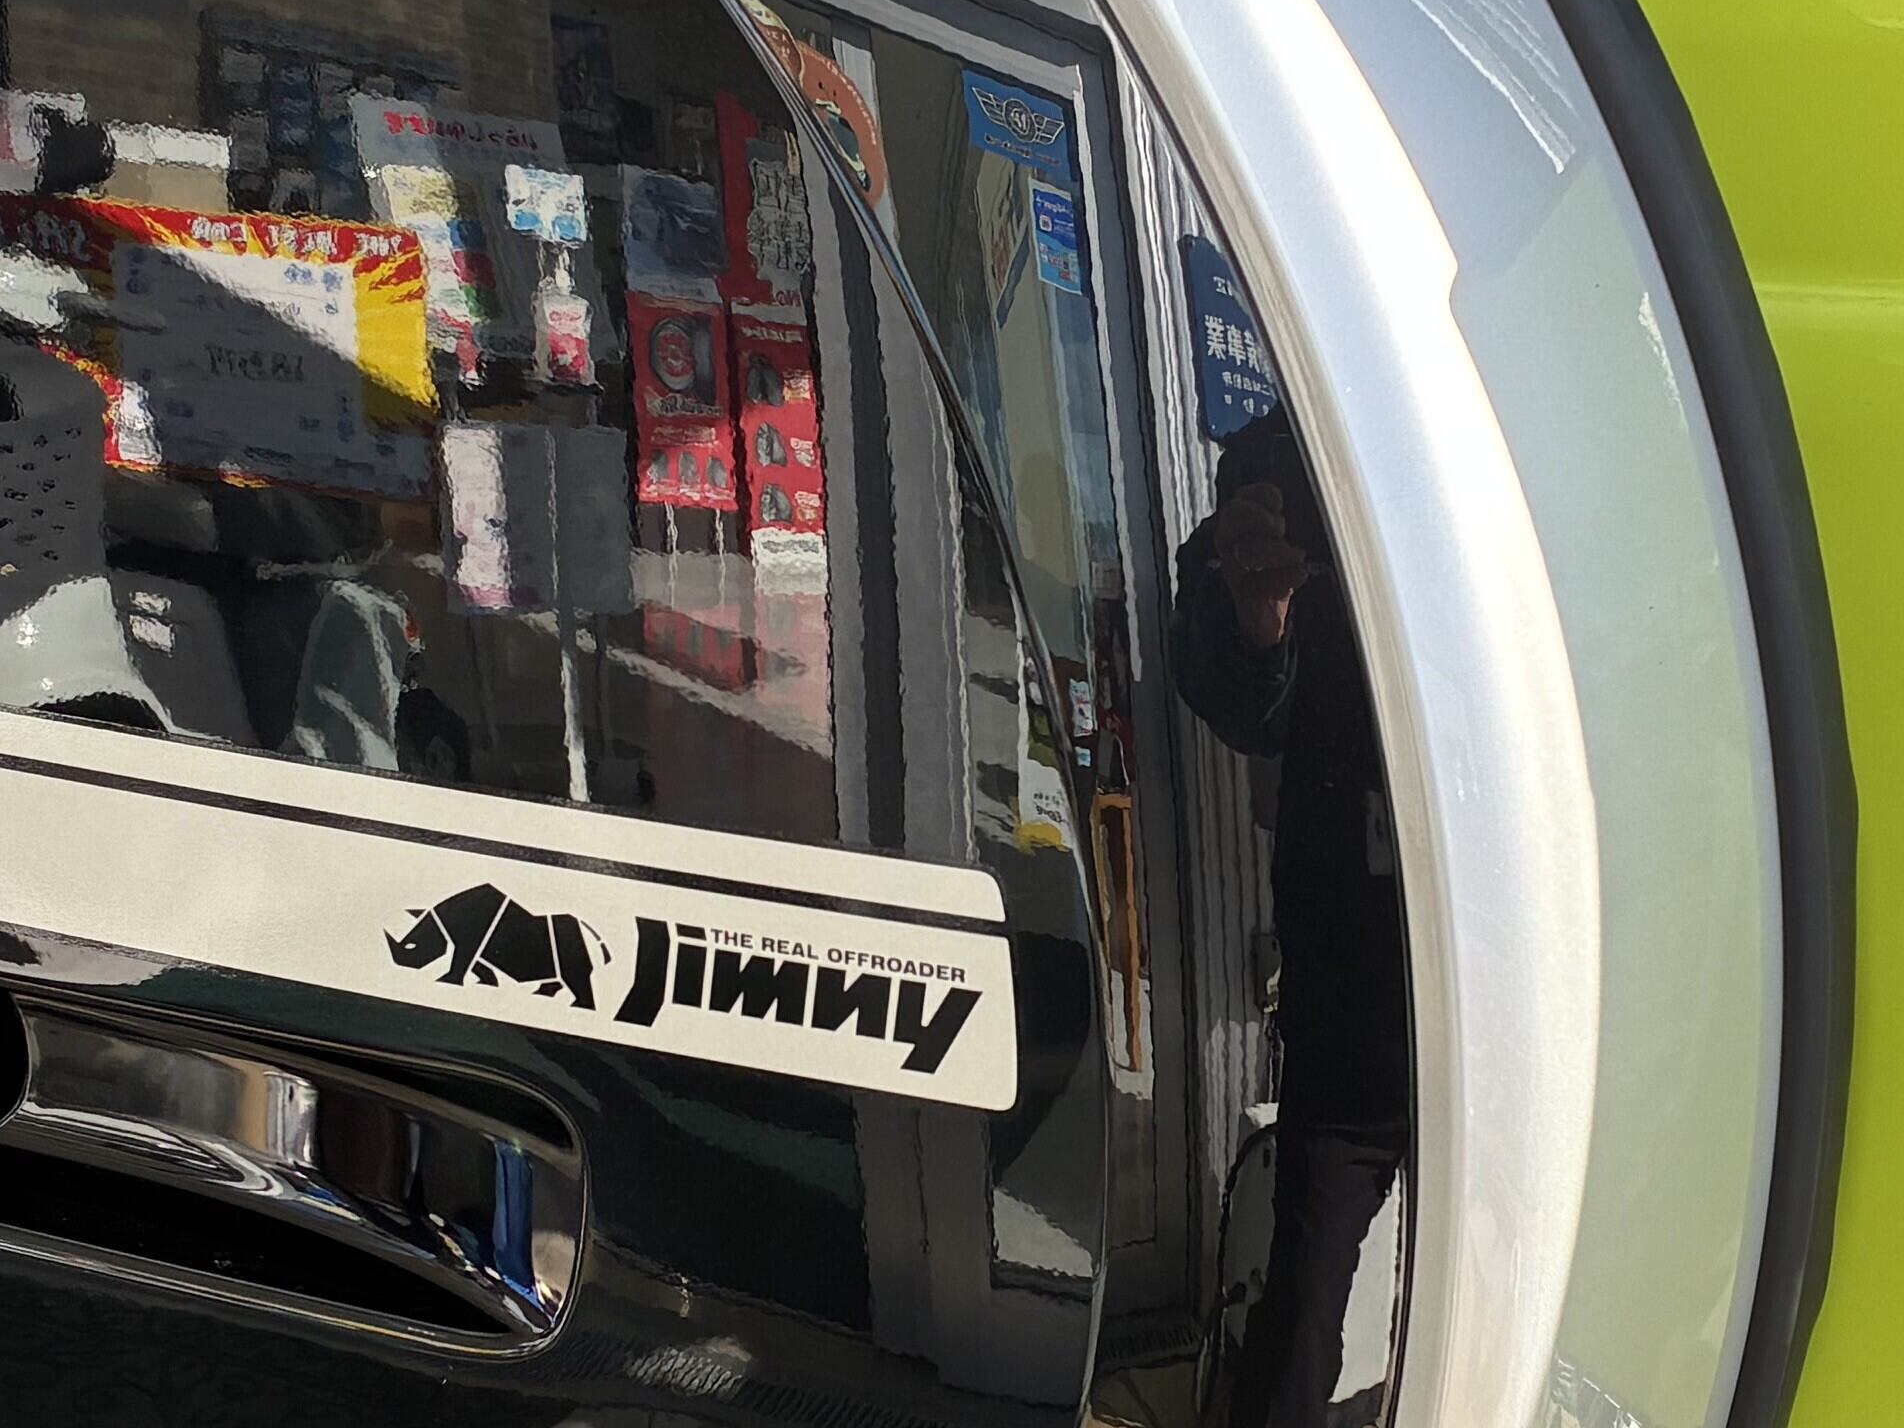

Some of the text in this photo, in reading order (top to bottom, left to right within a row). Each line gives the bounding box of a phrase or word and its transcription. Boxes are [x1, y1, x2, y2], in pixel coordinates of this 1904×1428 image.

[709, 927, 967, 985] THE REAL OFFROADER
